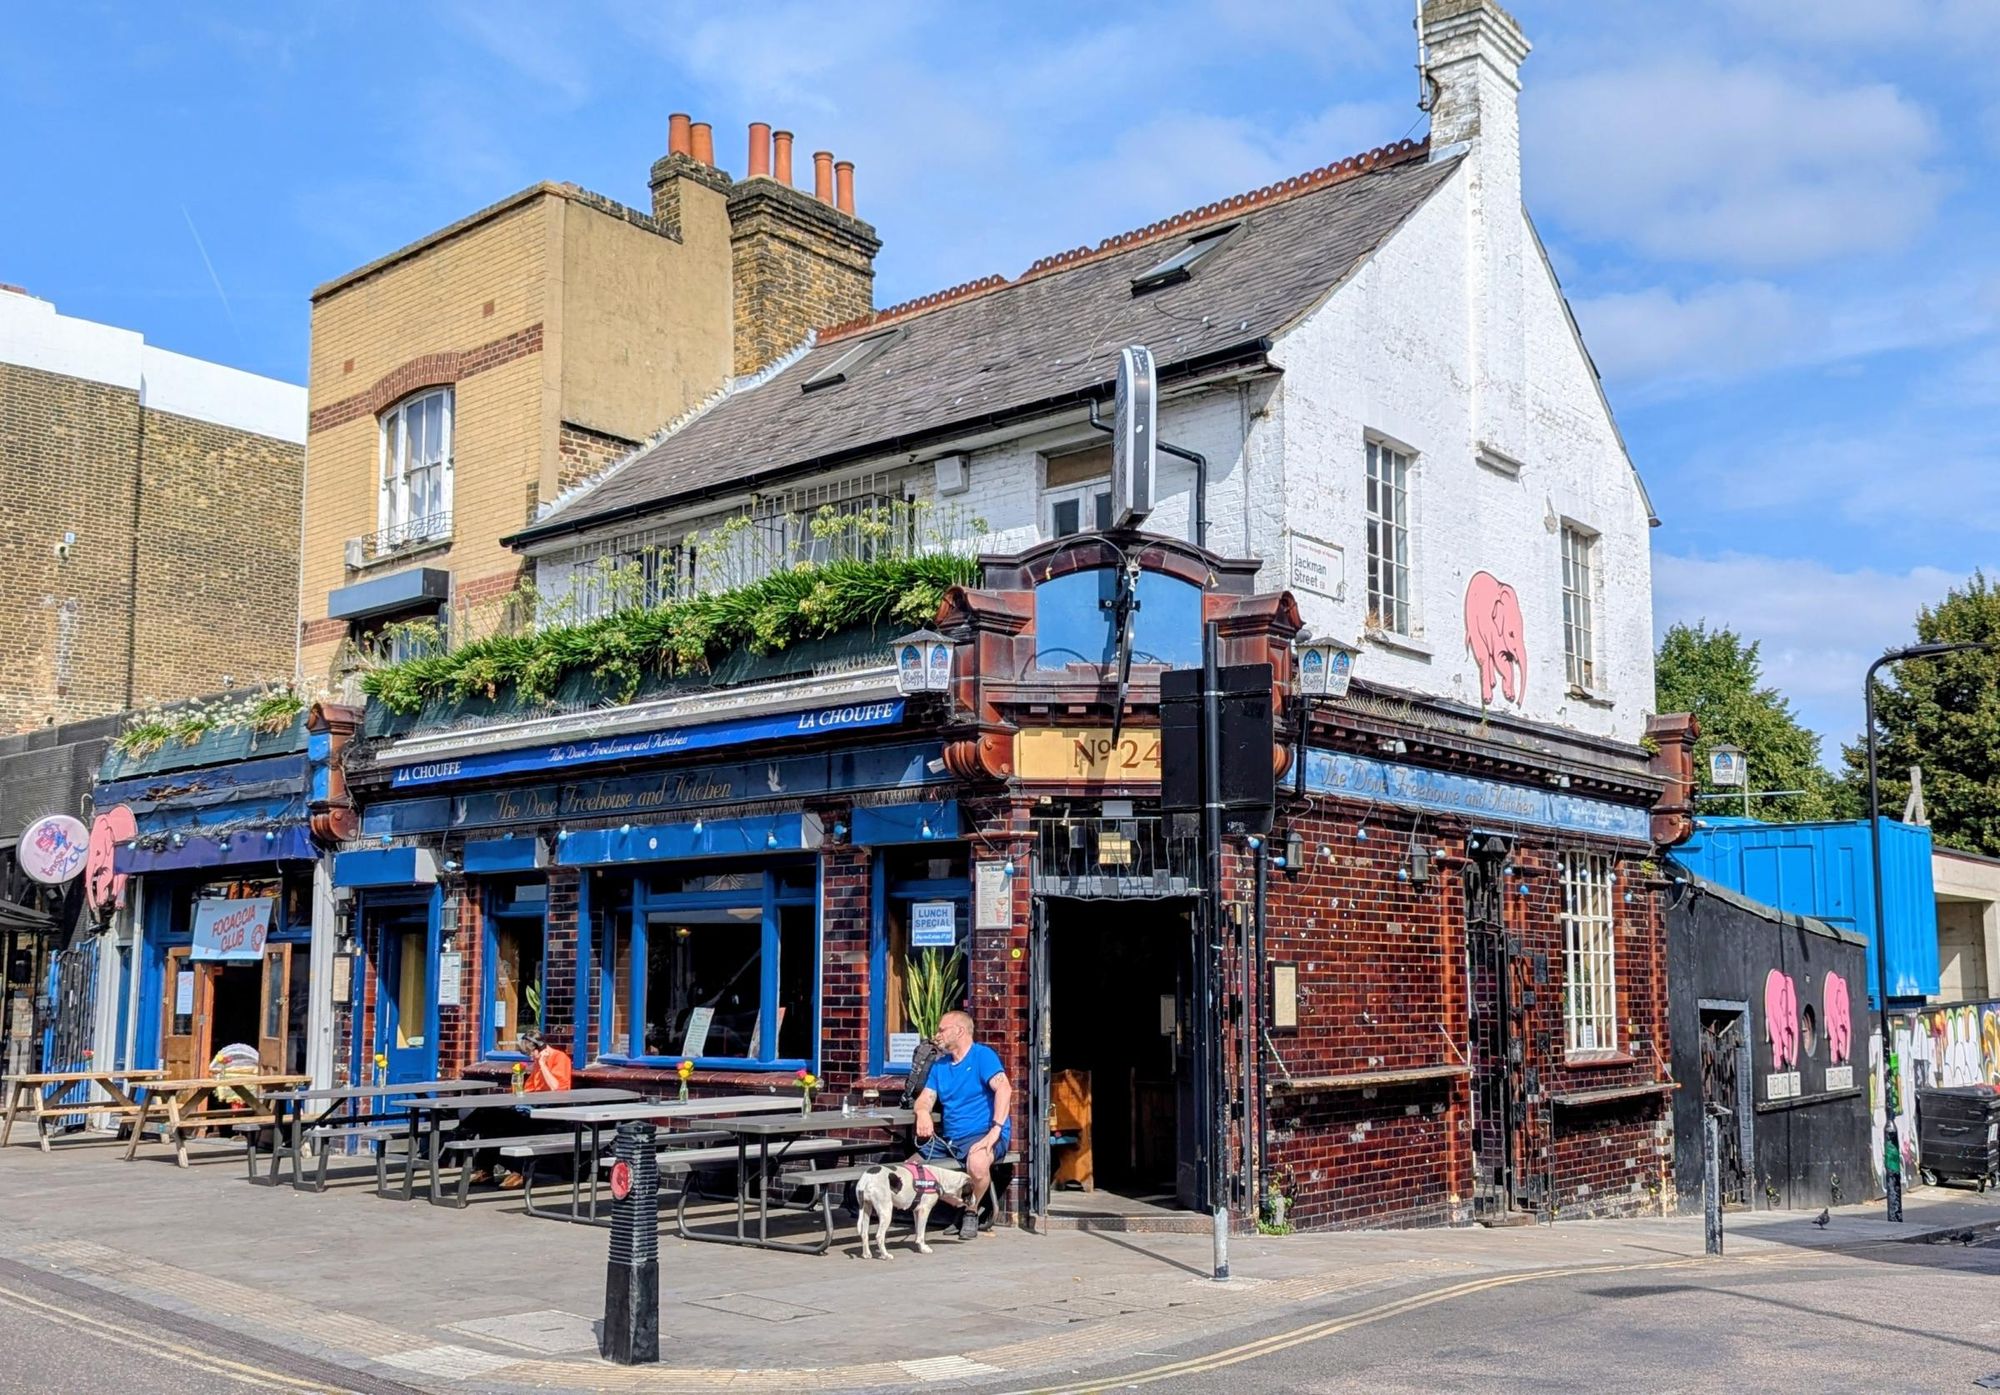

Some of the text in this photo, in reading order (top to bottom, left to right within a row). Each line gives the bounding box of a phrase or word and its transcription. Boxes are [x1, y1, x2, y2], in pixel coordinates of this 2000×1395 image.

[1294, 553, 1327, 576] Jackman
[1294, 568, 1318, 588] Street
[797, 702, 894, 729] LA CHOUFFE
[547, 730, 689, 762] The Dove Freehouse and Kitchen
[1120, 739, 1161, 769] 24
[397, 761, 462, 782] LA CHOUFFE
[1319, 755, 1347, 788] The
[1352, 762, 1387, 793] Dove
[1393, 768, 1460, 804] Freehouse
[491, 772, 731, 820] The Dove Freehouse and Kitchen
[212, 904, 256, 938] FOCACCIA
[914, 918, 952, 928] SPECIAL
[918, 908, 948, 918] LUNCH
[221, 927, 245, 952] CLUB
